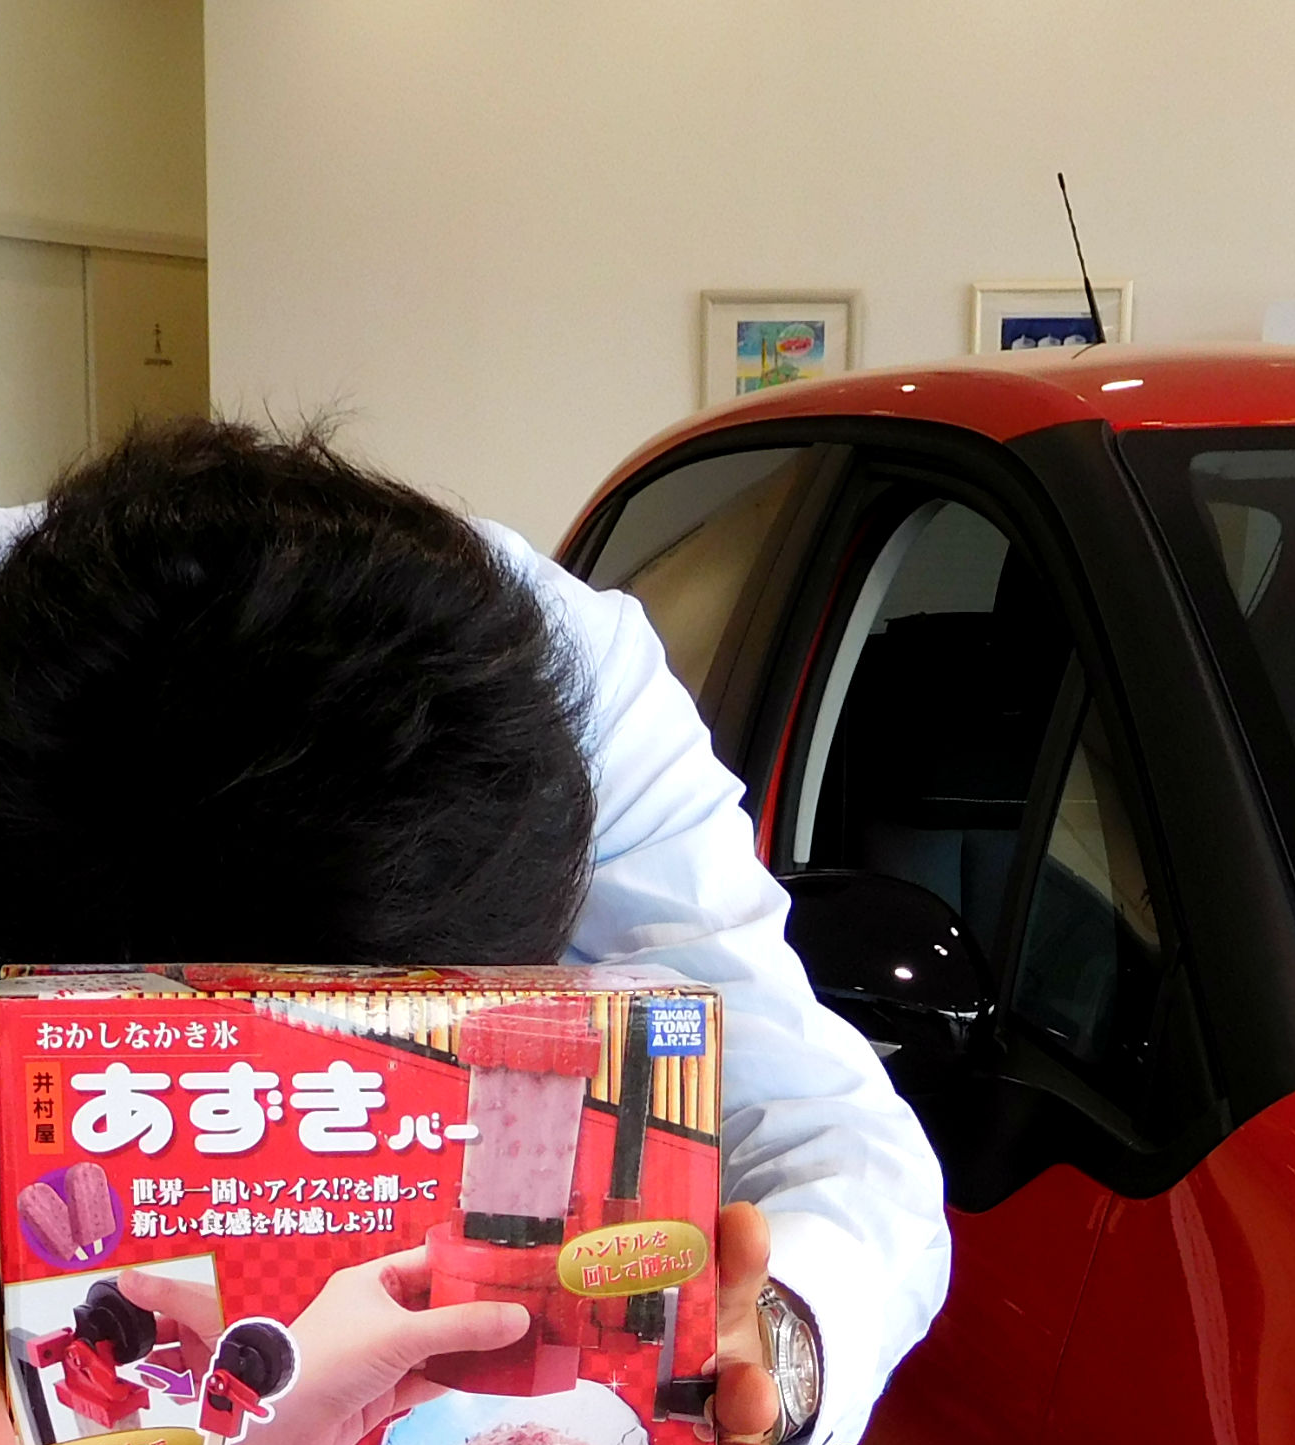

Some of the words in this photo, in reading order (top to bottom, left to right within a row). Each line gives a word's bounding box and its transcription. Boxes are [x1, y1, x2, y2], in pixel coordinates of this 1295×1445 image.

[652, 1009, 702, 1021] TAKARA
[652, 1021, 700, 1034] TOMY
[36, 1020, 240, 1050] おかしなかき氷
[32, 1072, 56, 1145] 井村屋
[572, 1230, 670, 1261] ハンドルを
